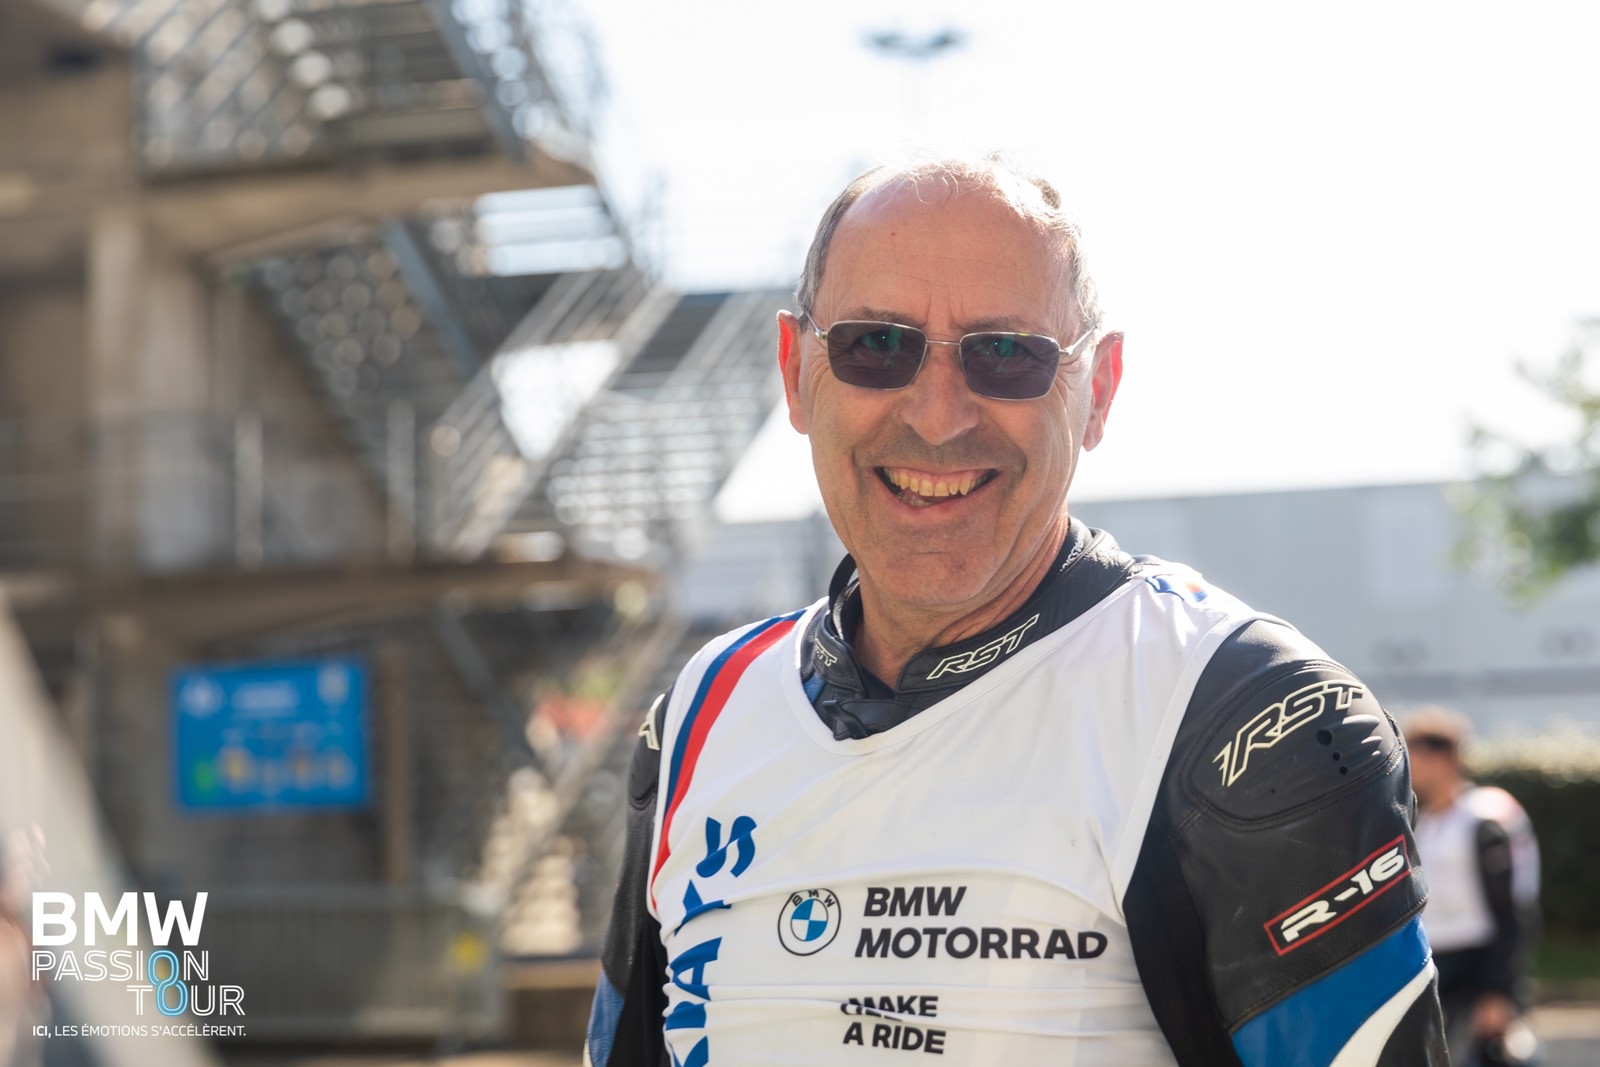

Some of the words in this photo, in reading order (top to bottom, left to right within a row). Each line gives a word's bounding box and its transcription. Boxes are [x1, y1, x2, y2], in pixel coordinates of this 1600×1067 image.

[926, 613, 1040, 680] RST
[1212, 679, 1366, 787] RST
[791, 889, 836, 908] BMW
[863, 886, 967, 917] BMW
[1280, 846, 1405, 943] R-16
[854, 927, 1109, 960] MOTORRAD
[843, 1022, 864, 1046] A
[872, 1023, 947, 1055] RIDE
